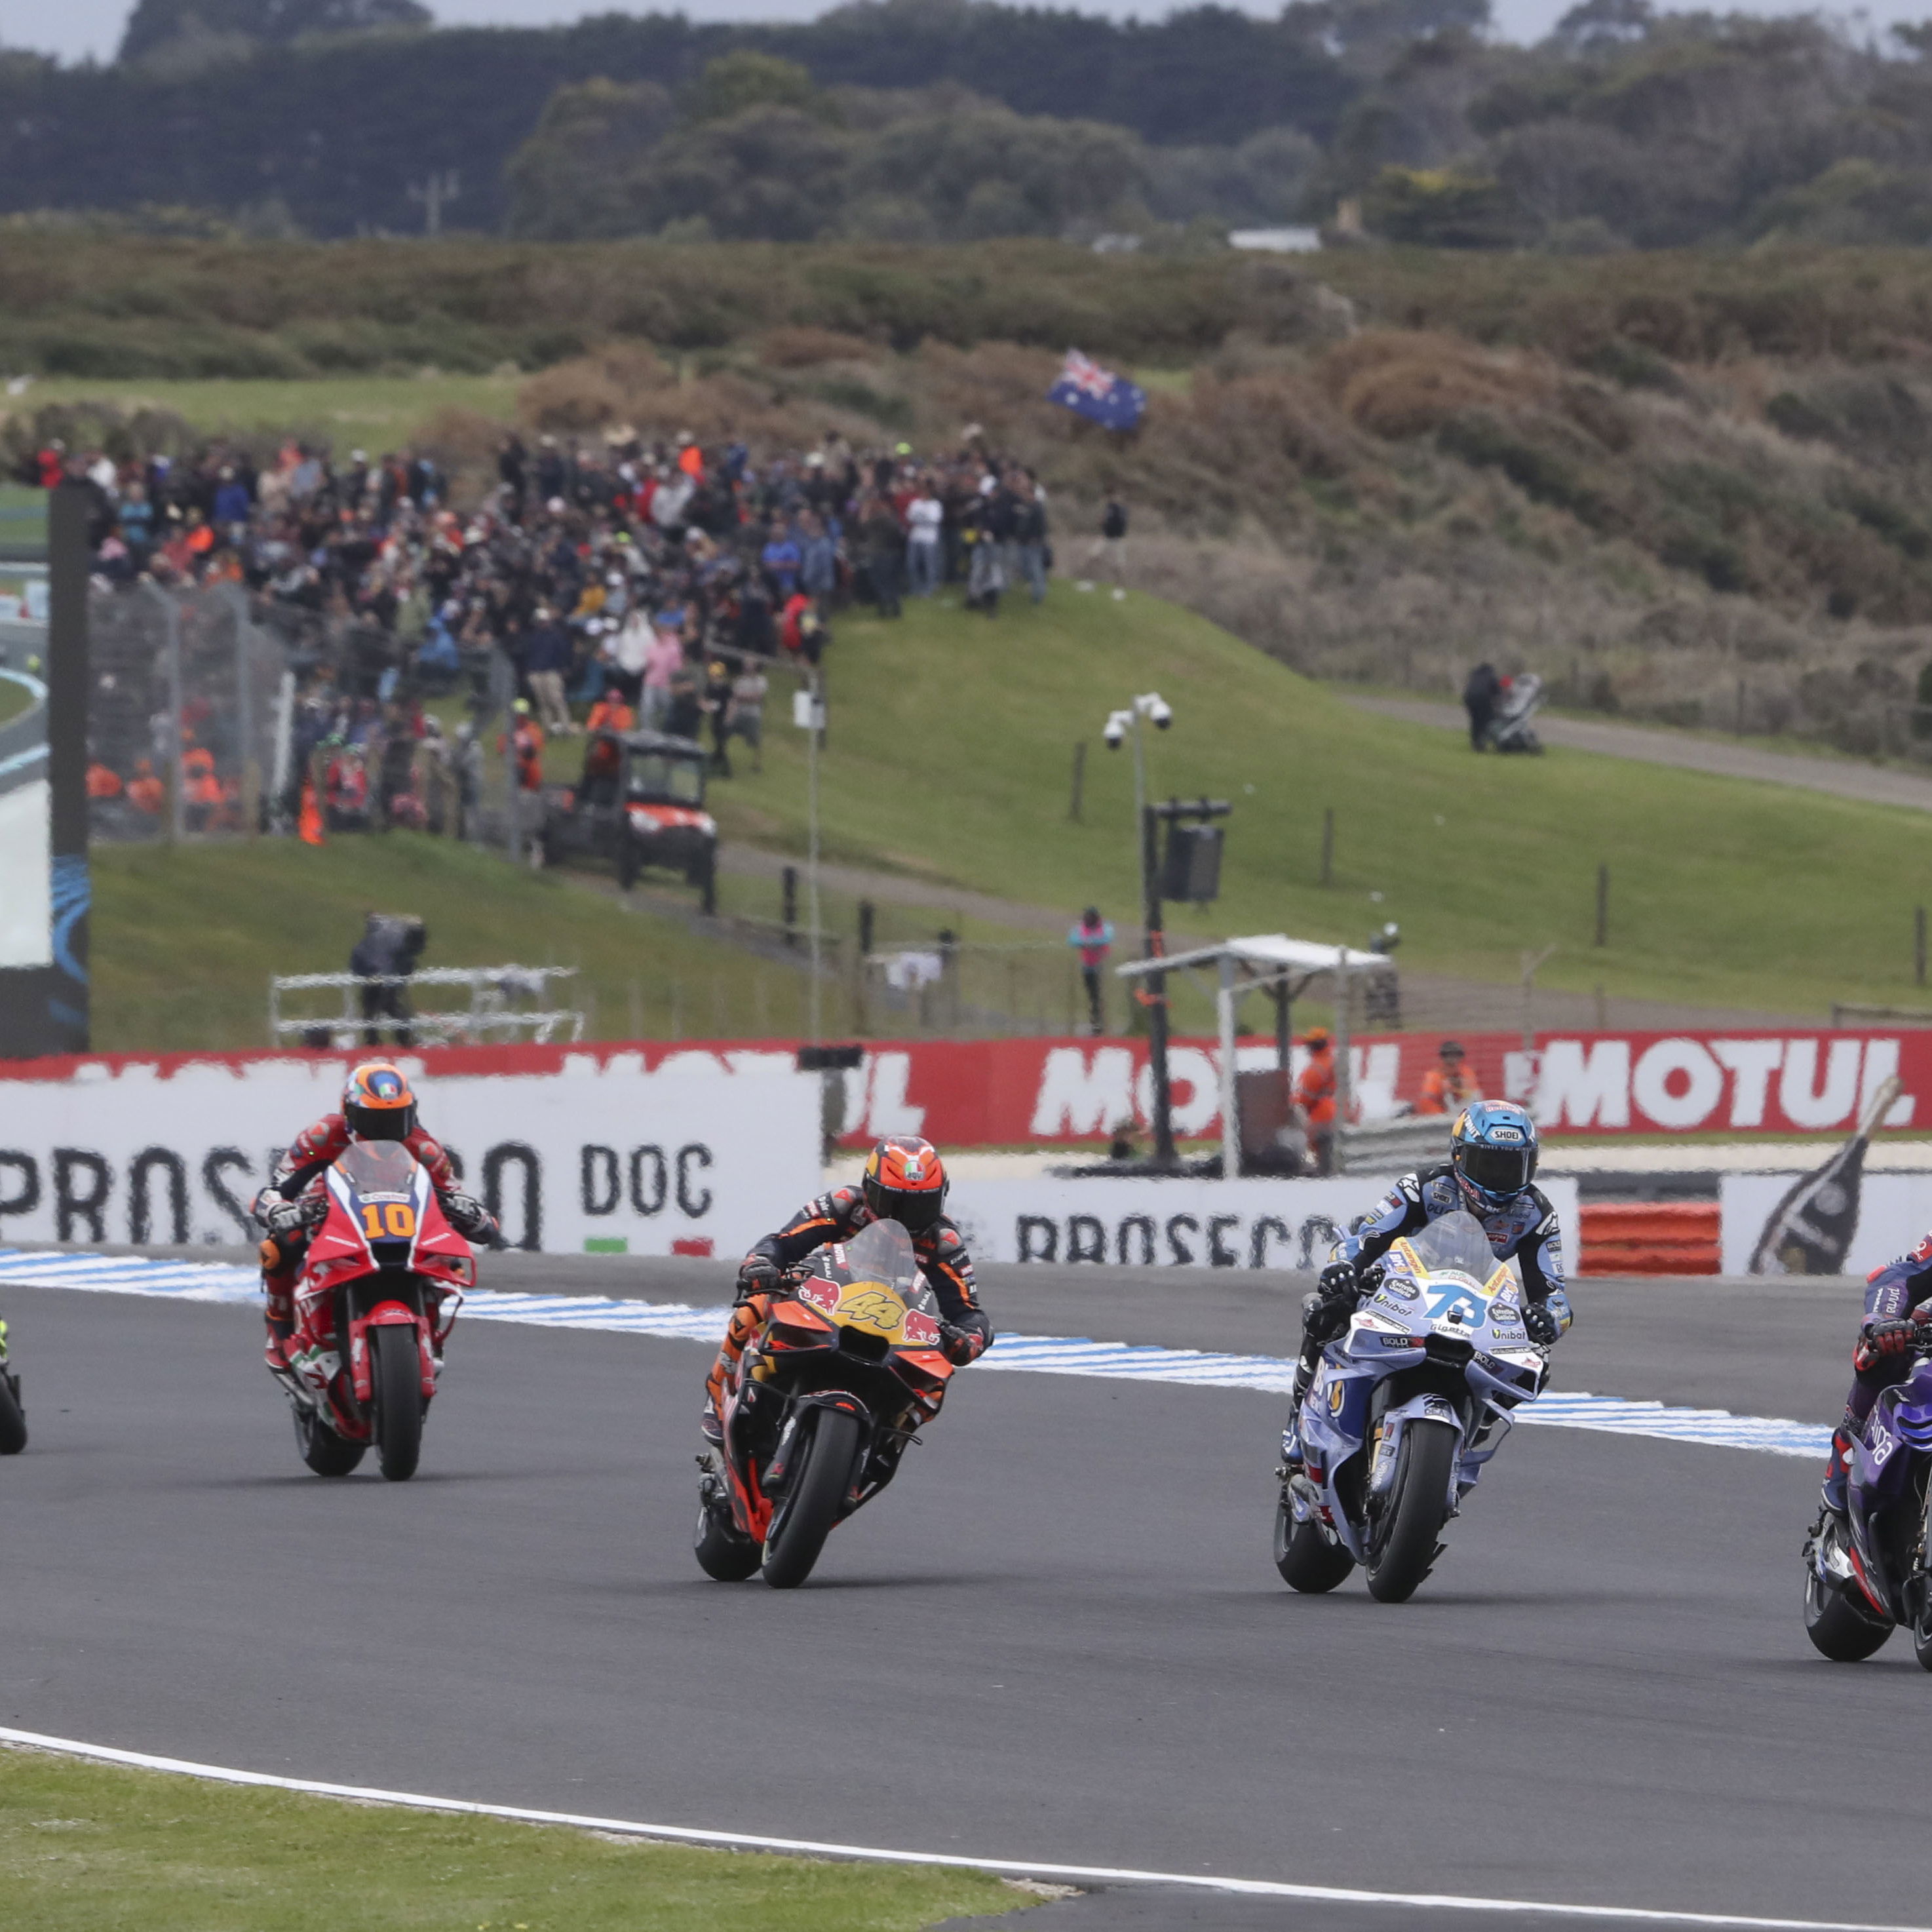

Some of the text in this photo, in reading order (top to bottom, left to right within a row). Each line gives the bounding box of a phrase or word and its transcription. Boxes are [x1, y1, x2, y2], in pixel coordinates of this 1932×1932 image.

[1534, 1037, 1916, 1129] MOTUL
[1495, 1131, 1518, 1140] SHOEI
[0, 1141, 714, 1251] PROSO DOC
[361, 1203, 417, 1239] 10
[1017, 1213, 1374, 1267] PROSECC
[838, 1290, 904, 1330] 44
[1374, 1294, 1413, 1317] Unibat
[1423, 1285, 1488, 1329] 73
[1492, 1329, 1526, 1340] Unibat
[1474, 1351, 1496, 1369] BOLD
